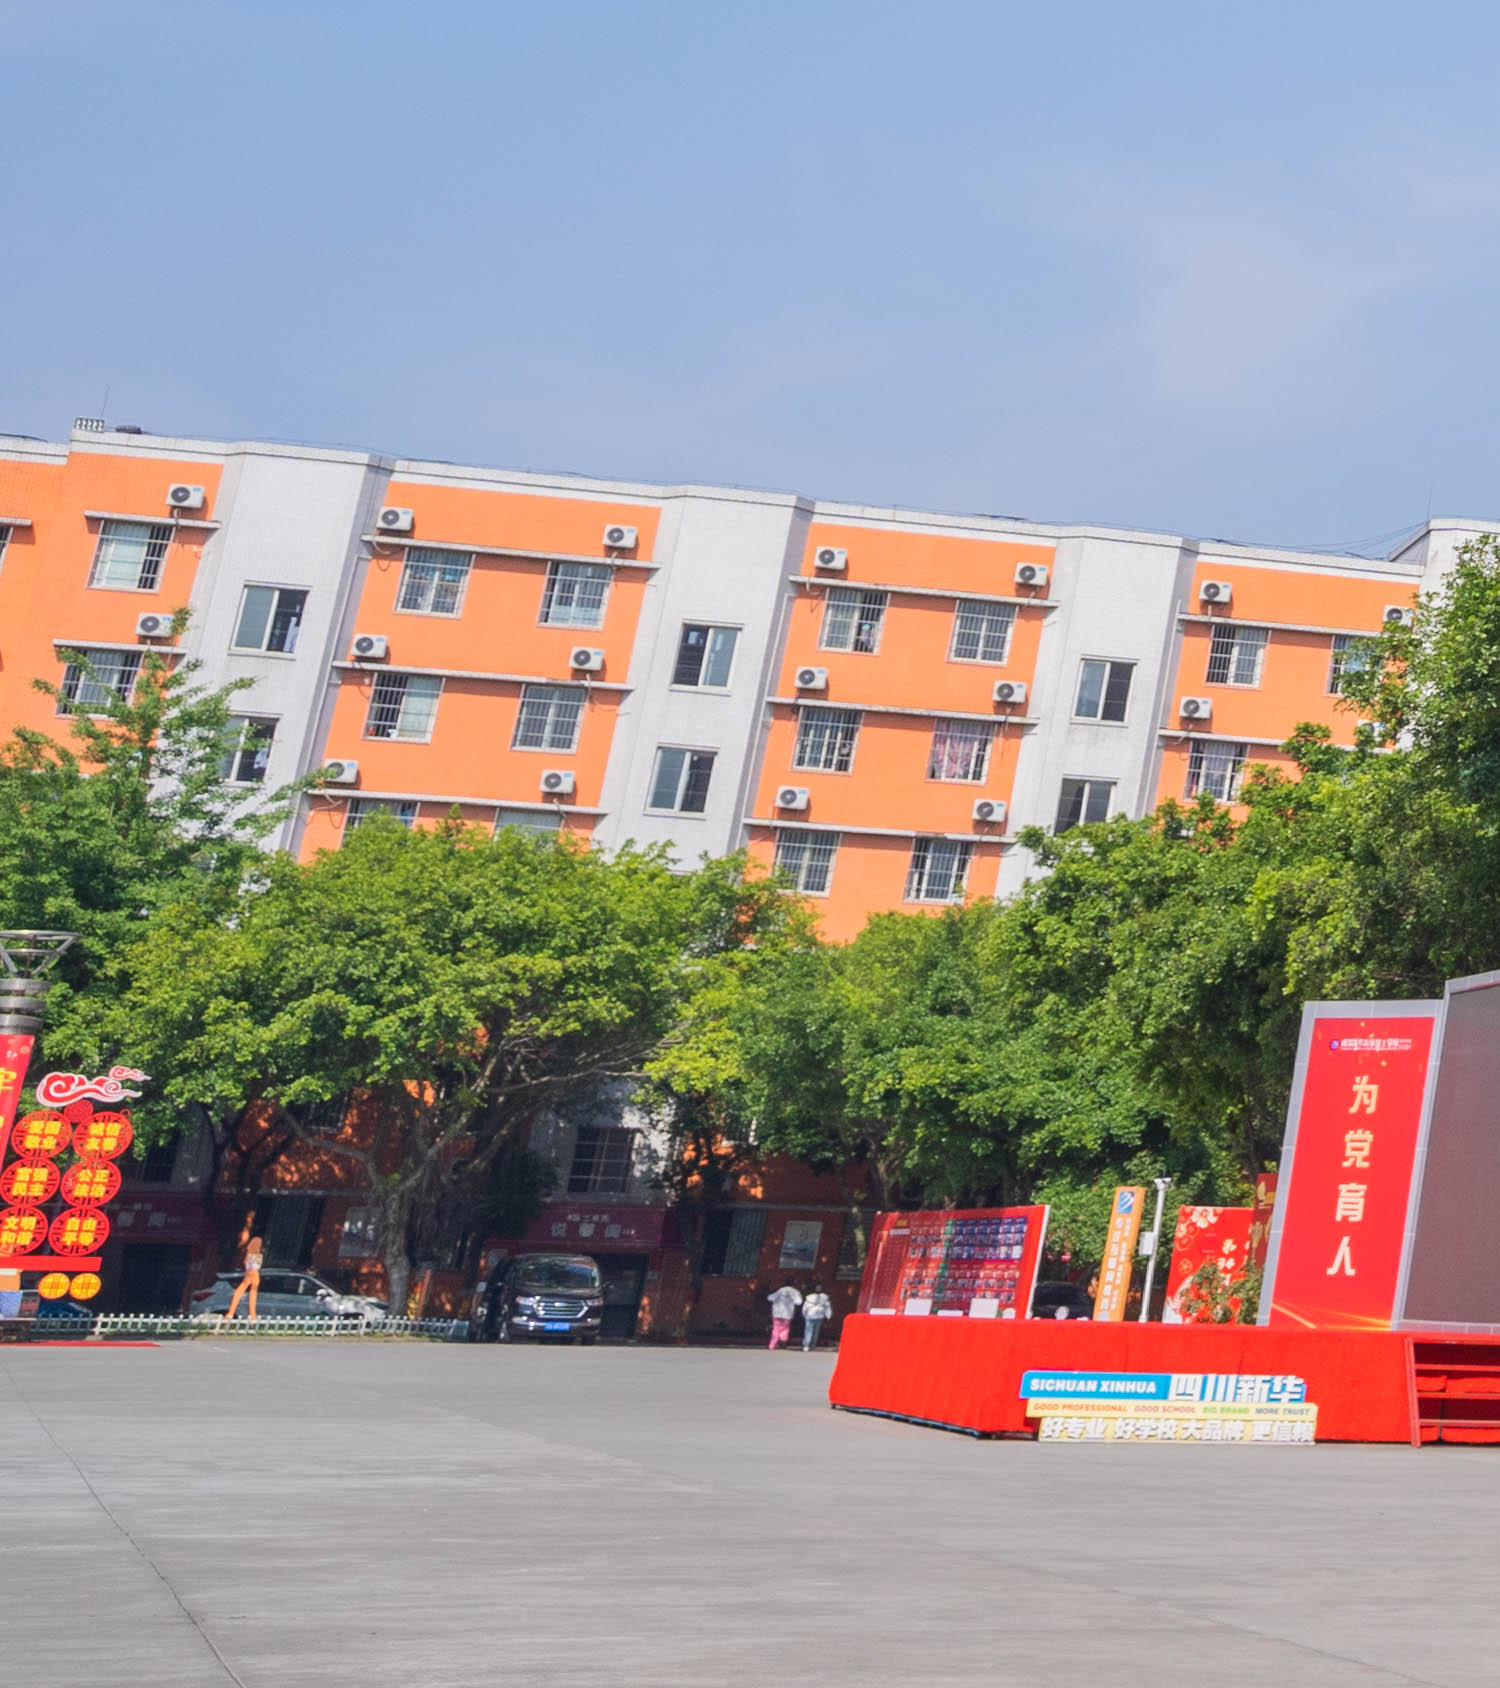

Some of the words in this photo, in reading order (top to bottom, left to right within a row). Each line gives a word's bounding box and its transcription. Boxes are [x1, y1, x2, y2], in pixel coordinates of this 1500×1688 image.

[1326, 1075, 1379, 1278] 为党育人
[1030, 1378, 1097, 1393] SICHUAN
[1100, 1380, 1156, 1394] XINHUA
[1169, 1374, 1305, 1404] 四川新华
[1042, 1417, 1106, 1441] 好专业
[1113, 1418, 1178, 1441] 好学校
[1182, 1419, 1245, 1442] 大品牌
[1251, 1420, 1315, 1443] 更信赖
